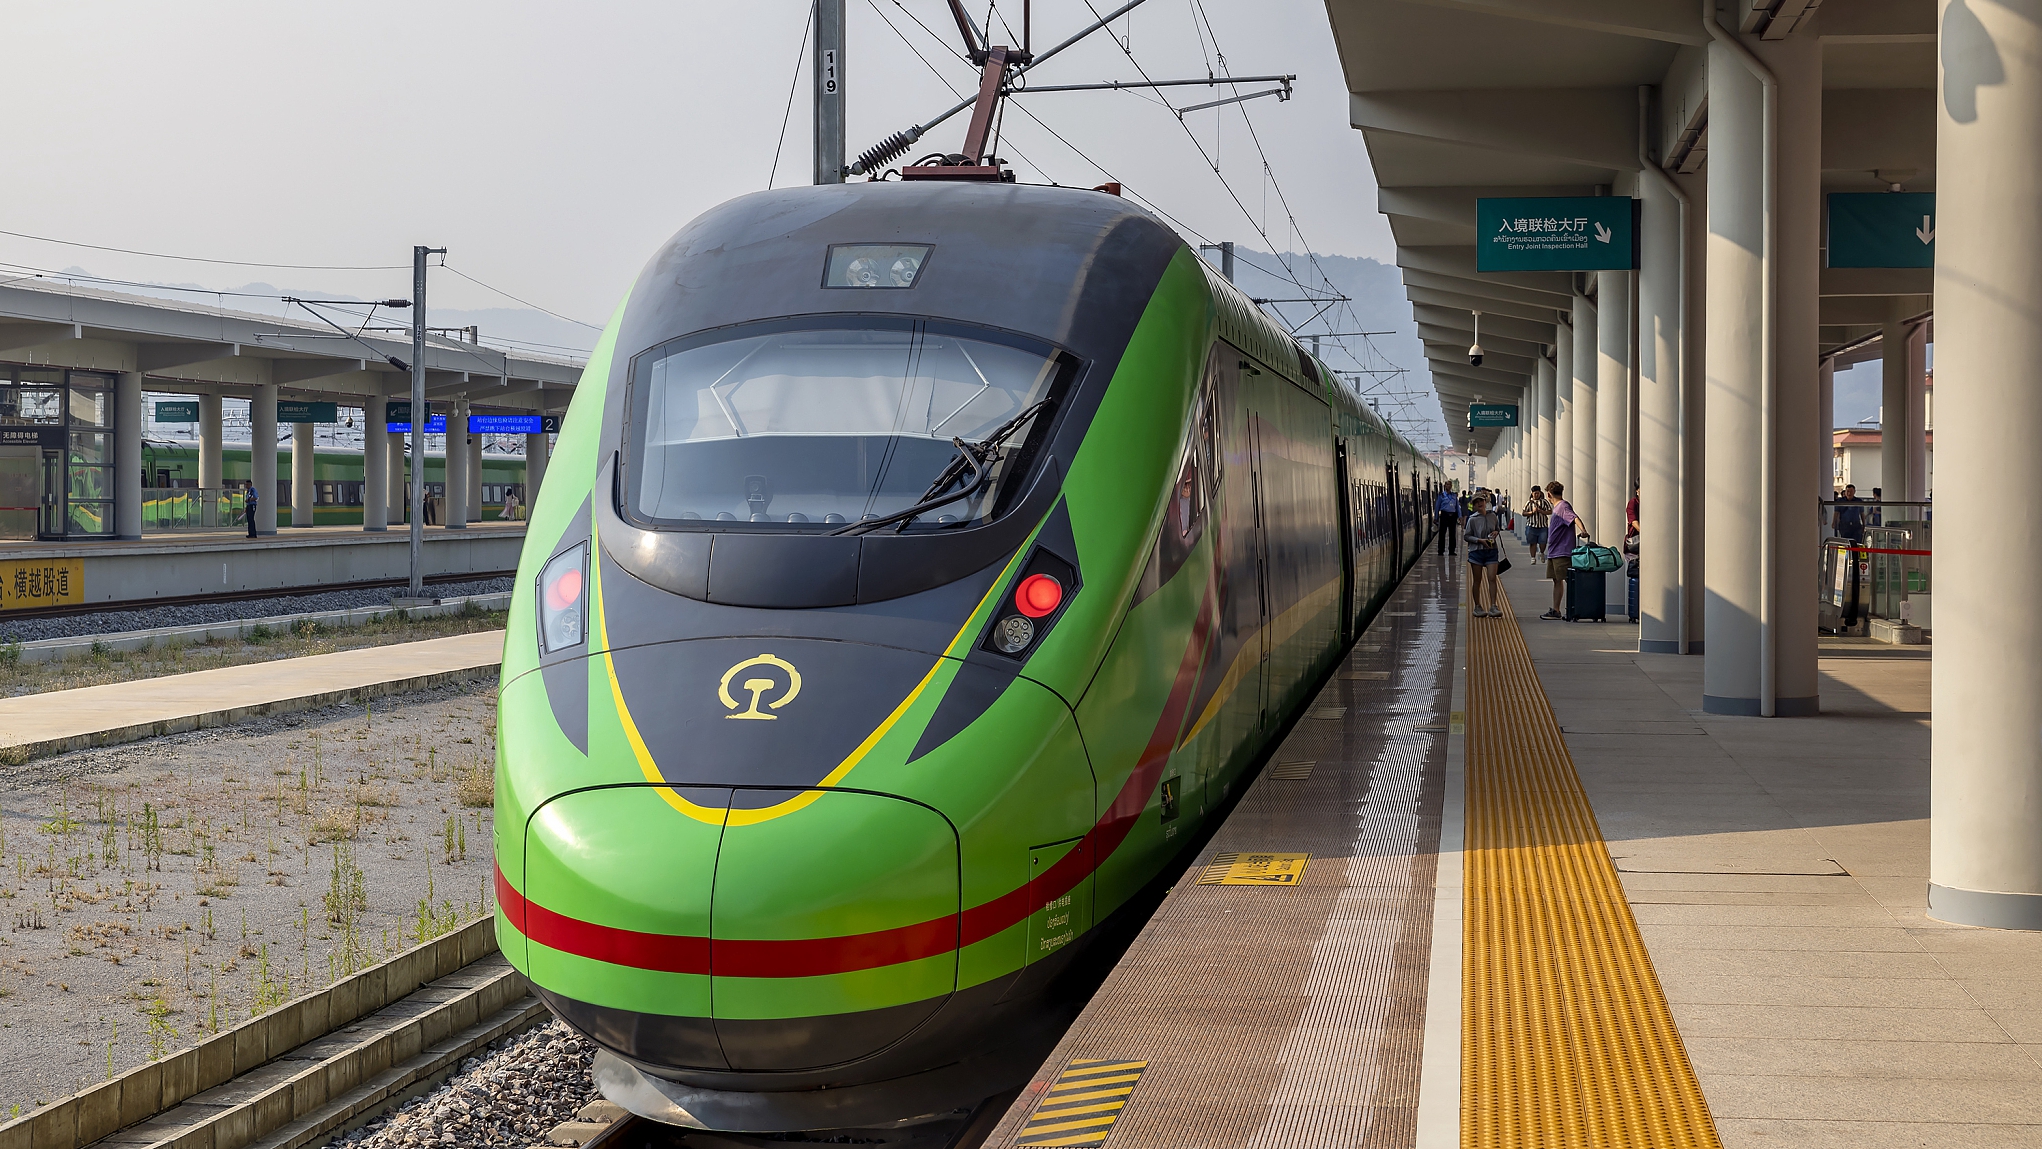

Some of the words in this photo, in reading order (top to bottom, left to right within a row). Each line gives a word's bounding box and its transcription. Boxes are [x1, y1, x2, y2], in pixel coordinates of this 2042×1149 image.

[826, 51, 837, 93] 119
[1498, 217, 1588, 233] 入境联检大厅
[545, 418, 554, 431] 2
[2, 431, 39, 440] 无障碍电梯
[0, 566, 69, 600] 、横越股道
